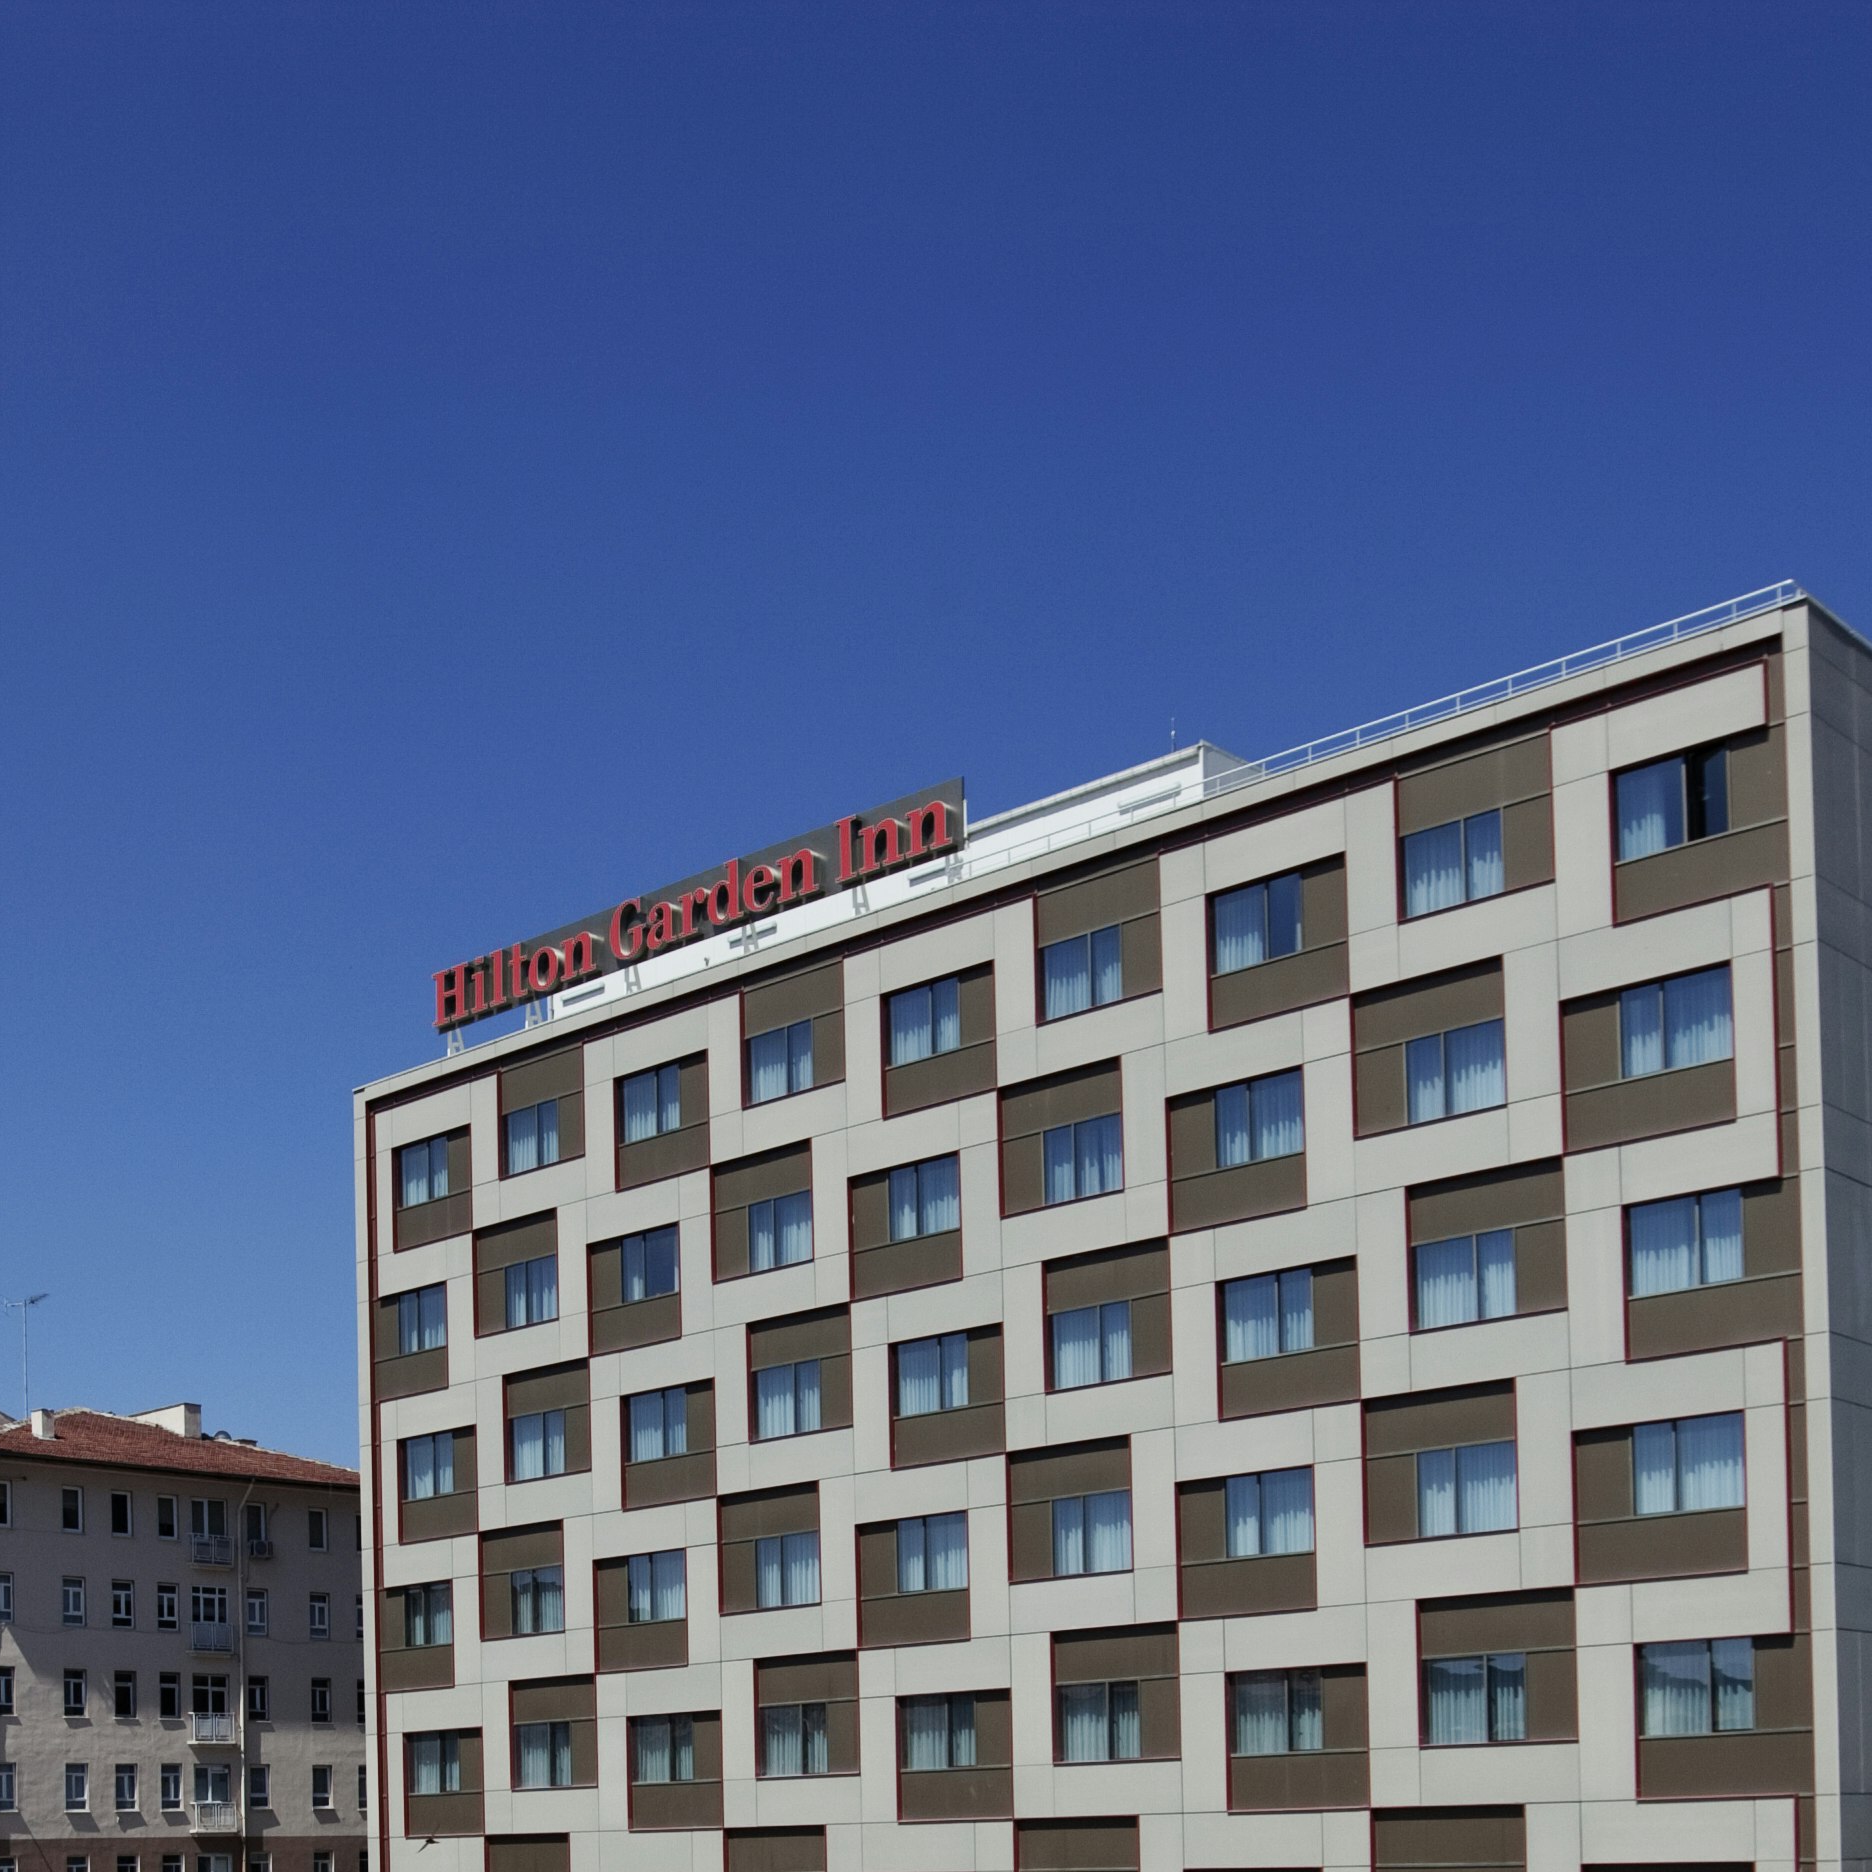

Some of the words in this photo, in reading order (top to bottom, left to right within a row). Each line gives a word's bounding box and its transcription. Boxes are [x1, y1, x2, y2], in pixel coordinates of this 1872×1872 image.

[432, 931, 596, 1026] Hilton
[609, 847, 819, 960] Garden
[836, 797, 953, 884] Inn
